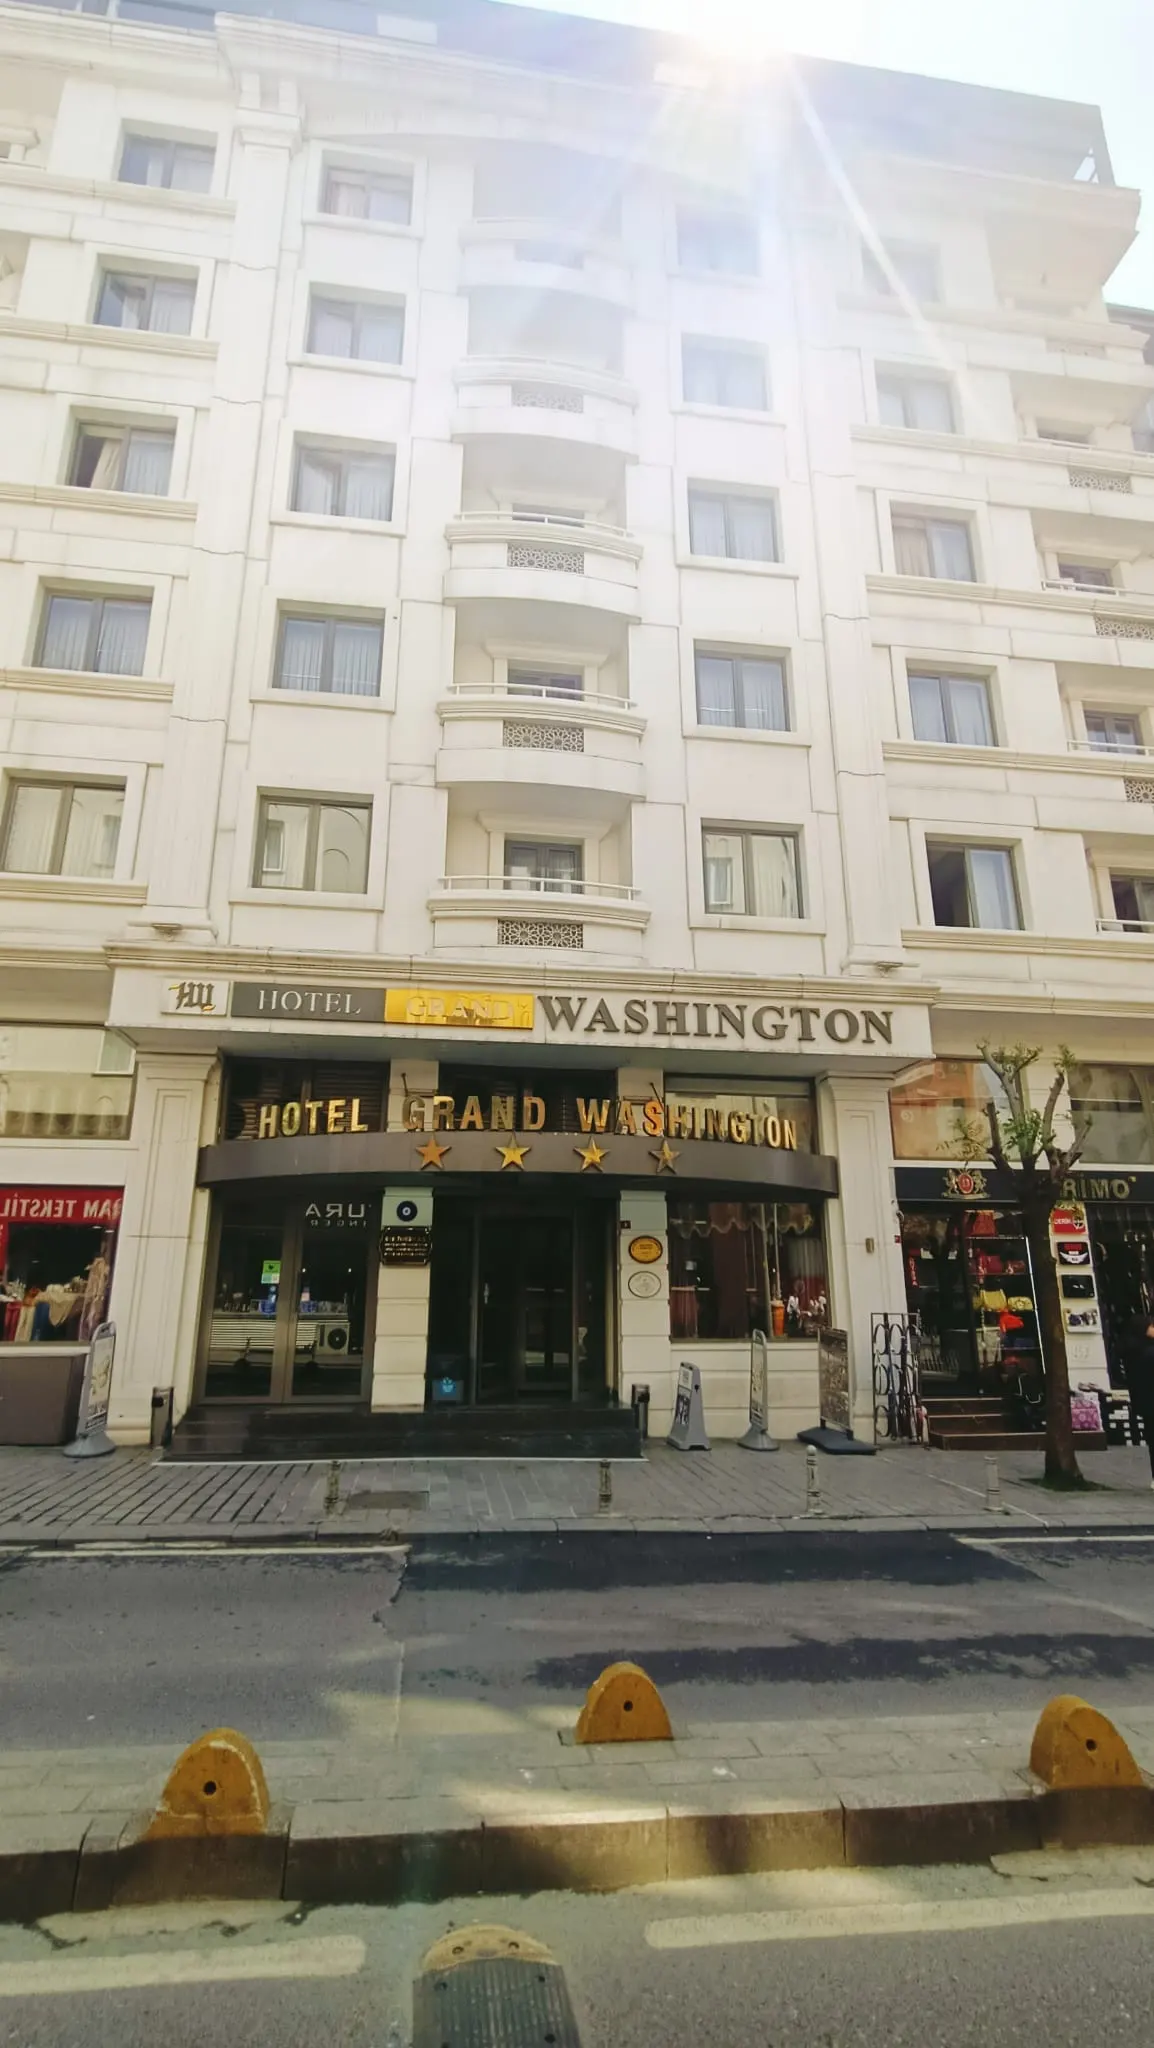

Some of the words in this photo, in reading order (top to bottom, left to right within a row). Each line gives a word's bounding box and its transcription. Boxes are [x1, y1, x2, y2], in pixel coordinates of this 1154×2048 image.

[258, 990, 362, 1015] HOTEL
[406, 996, 514, 1020] GRAND
[537, 996, 893, 1044] WASHINGTON
[259, 1098, 368, 1138] HOTEL
[402, 1095, 546, 1131] GRAND
[576, 1097, 797, 1150] WASHINGTON
